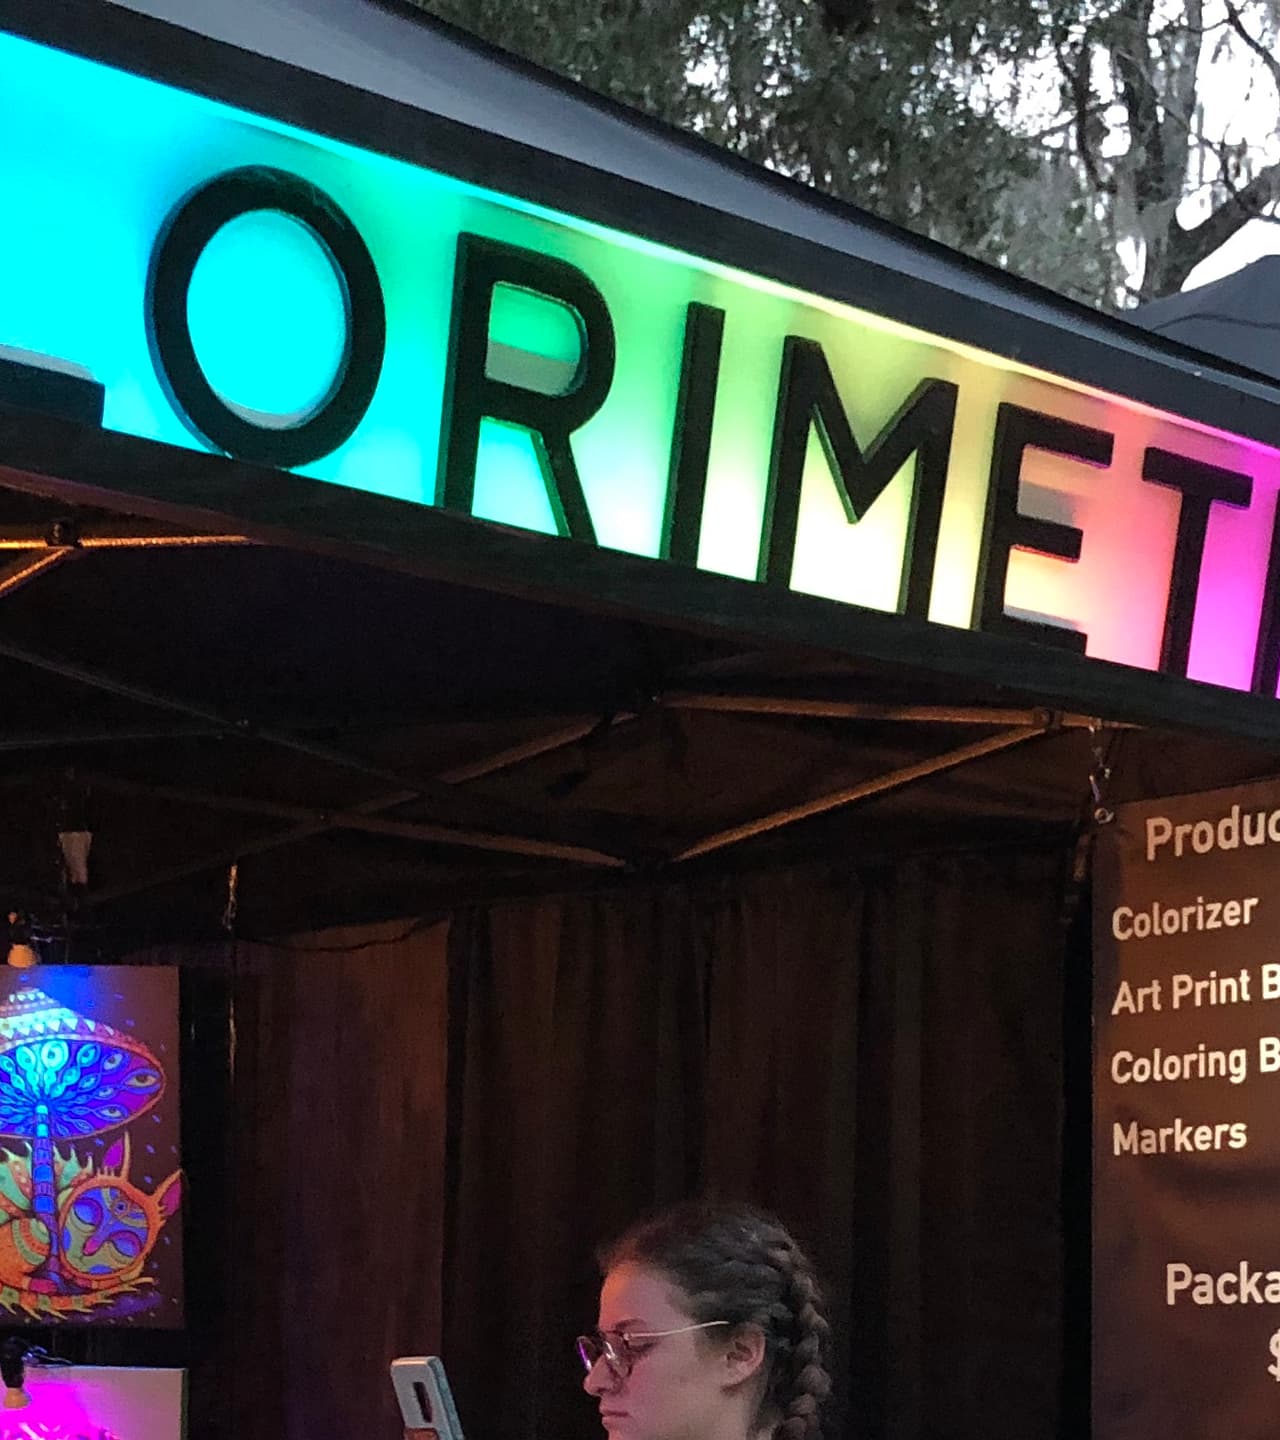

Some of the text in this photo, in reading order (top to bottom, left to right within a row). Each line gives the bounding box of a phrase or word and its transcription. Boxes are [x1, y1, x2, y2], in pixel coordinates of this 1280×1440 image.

[1112, 897, 1259, 940] Colorizer
[1112, 981, 1161, 1015] Art
[1171, 968, 1251, 1011] Print
[1111, 1042, 1247, 1084] Coloring
[1113, 1119, 1248, 1156] Markers
